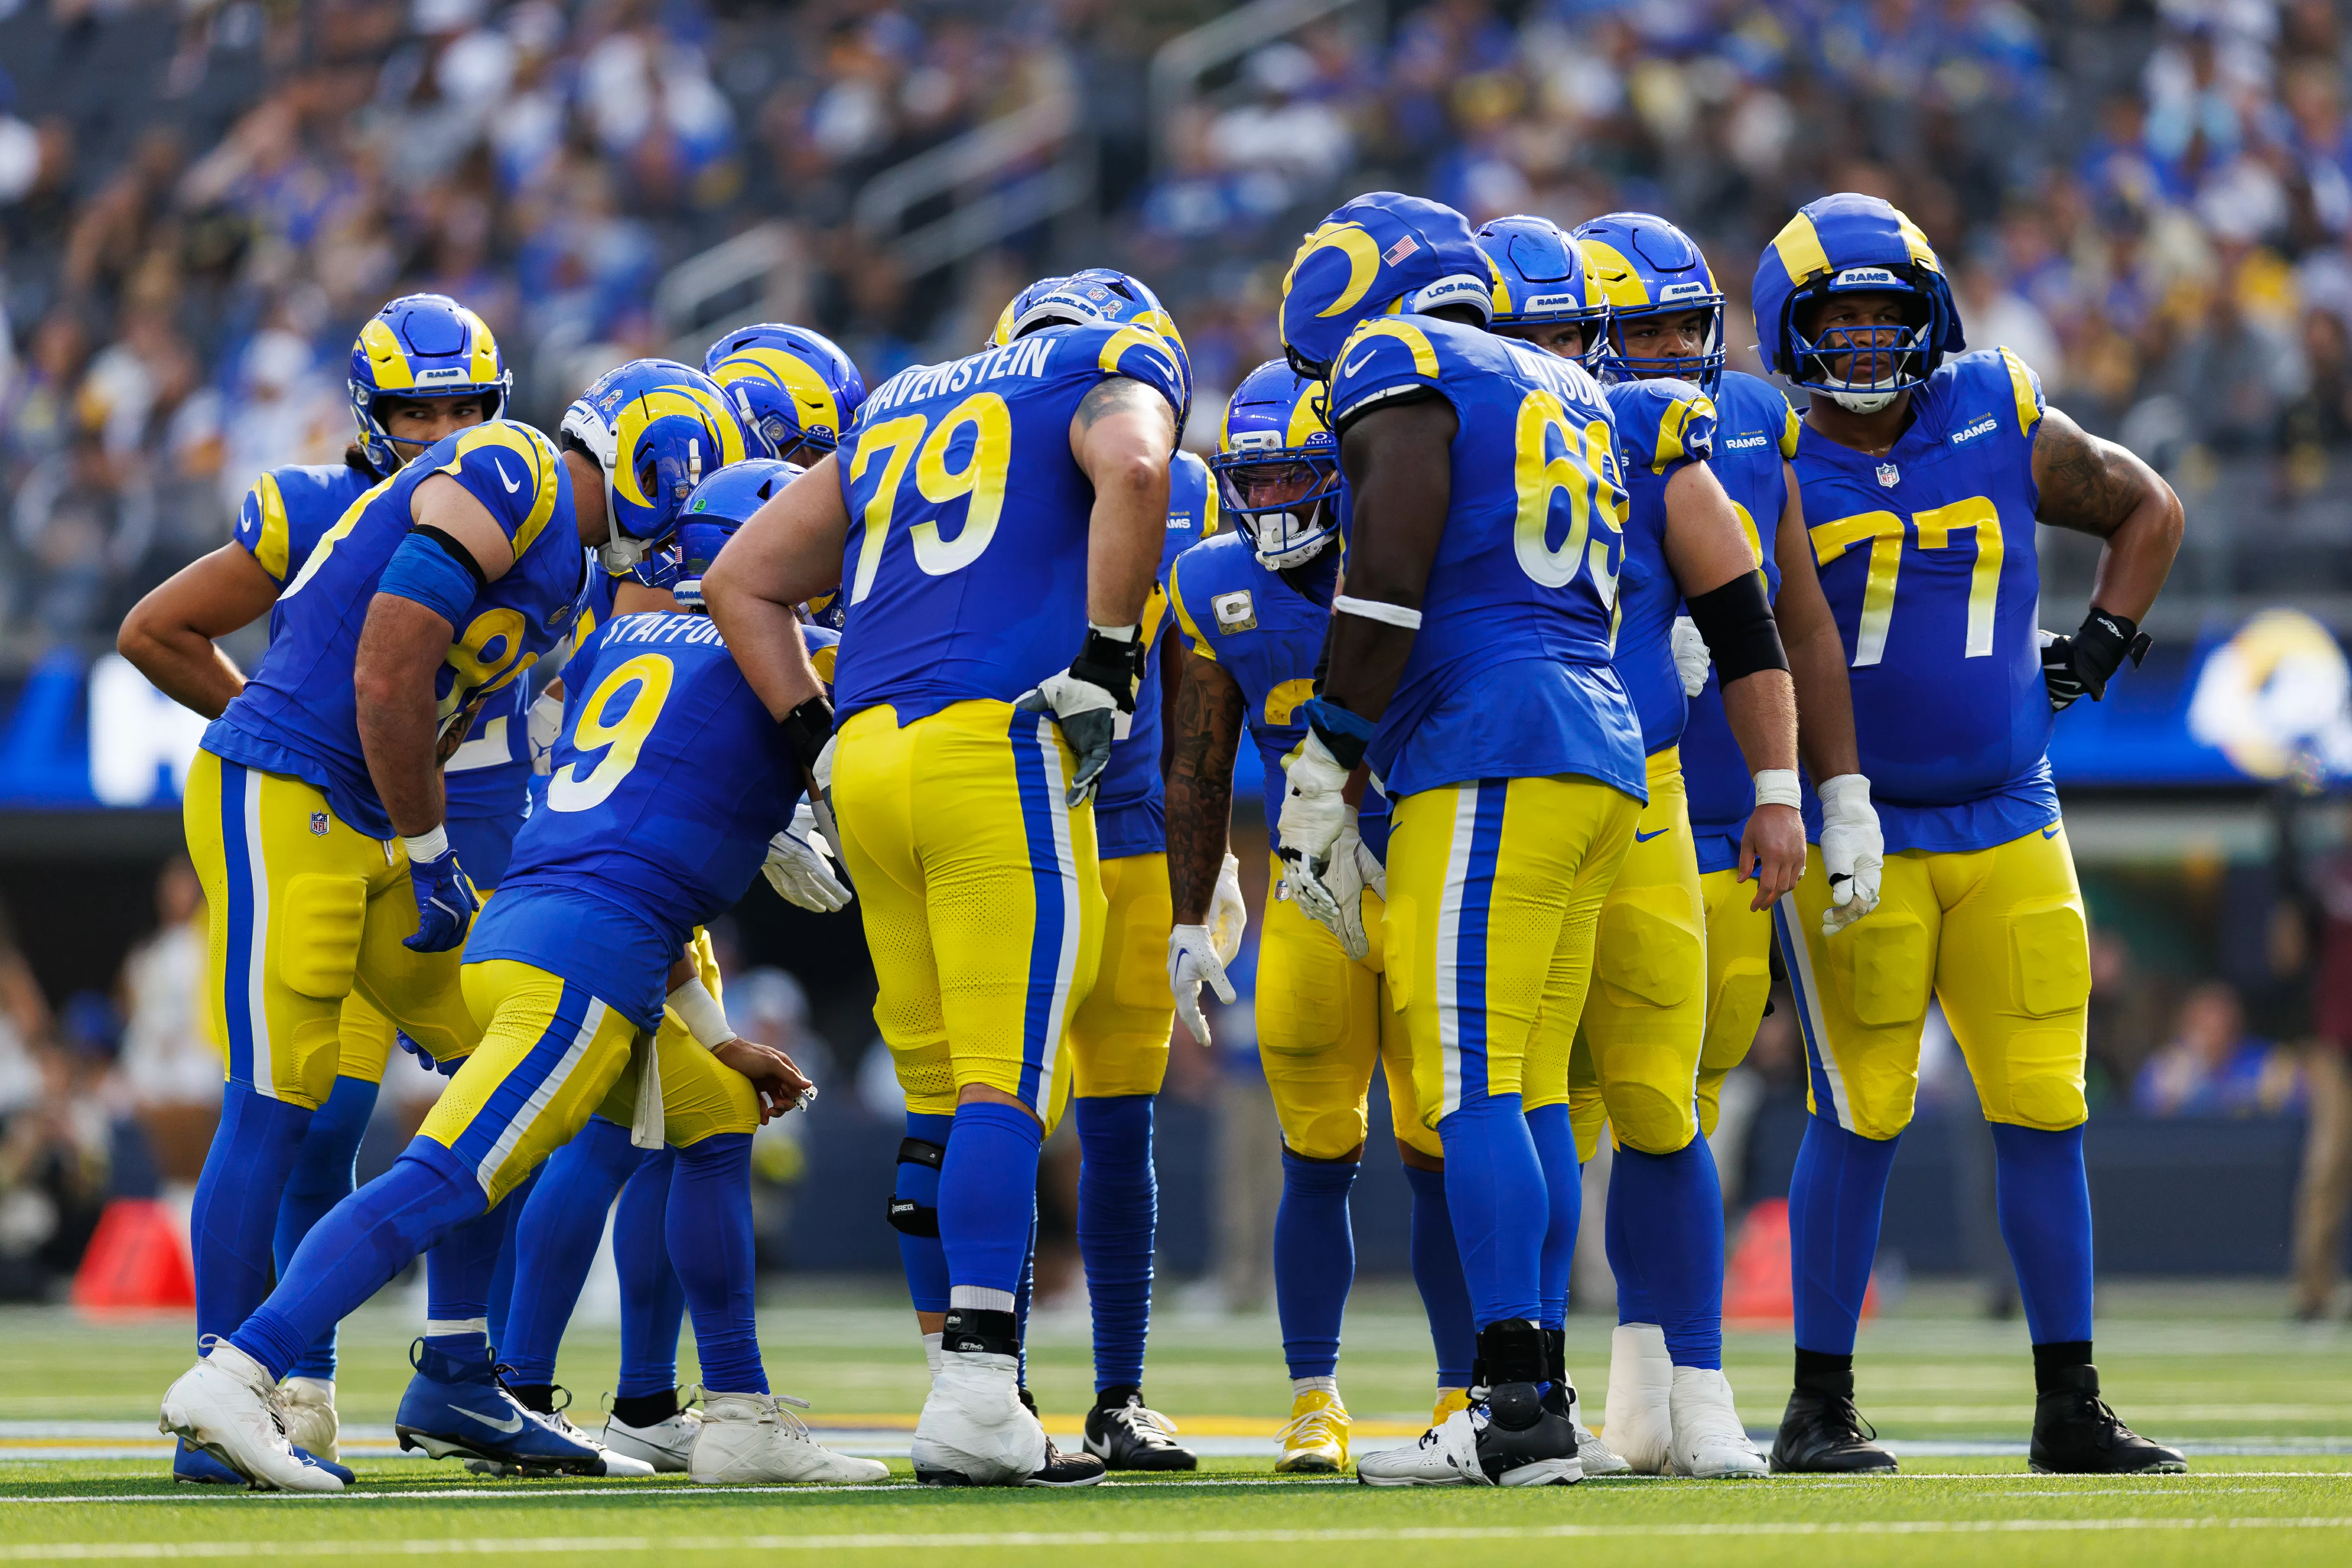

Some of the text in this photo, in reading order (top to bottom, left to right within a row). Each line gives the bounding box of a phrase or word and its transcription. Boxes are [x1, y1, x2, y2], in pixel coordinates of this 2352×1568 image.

[1846, 273, 1889, 281] RAMS
[1427, 284, 1455, 298] LOS
[1671, 285, 1700, 294] RAMS
[1537, 297, 1569, 305] RAMS
[427, 370, 459, 378] RAMS
[862, 338, 1057, 427] HAVENSTEIN
[807, 430, 832, 438] OAKLEY
[1952, 419, 1997, 444] RAMS
[1726, 436, 1767, 449] RAMS
[1882, 473, 1896, 483] NFL
[850, 392, 1012, 607] 79
[1514, 389, 1629, 611] 69
[1166, 518, 1191, 528] AMS
[1809, 495, 2004, 667] 77
[1216, 593, 1250, 624] C
[547, 653, 674, 812] 9
[313, 822, 326, 832] NFL
